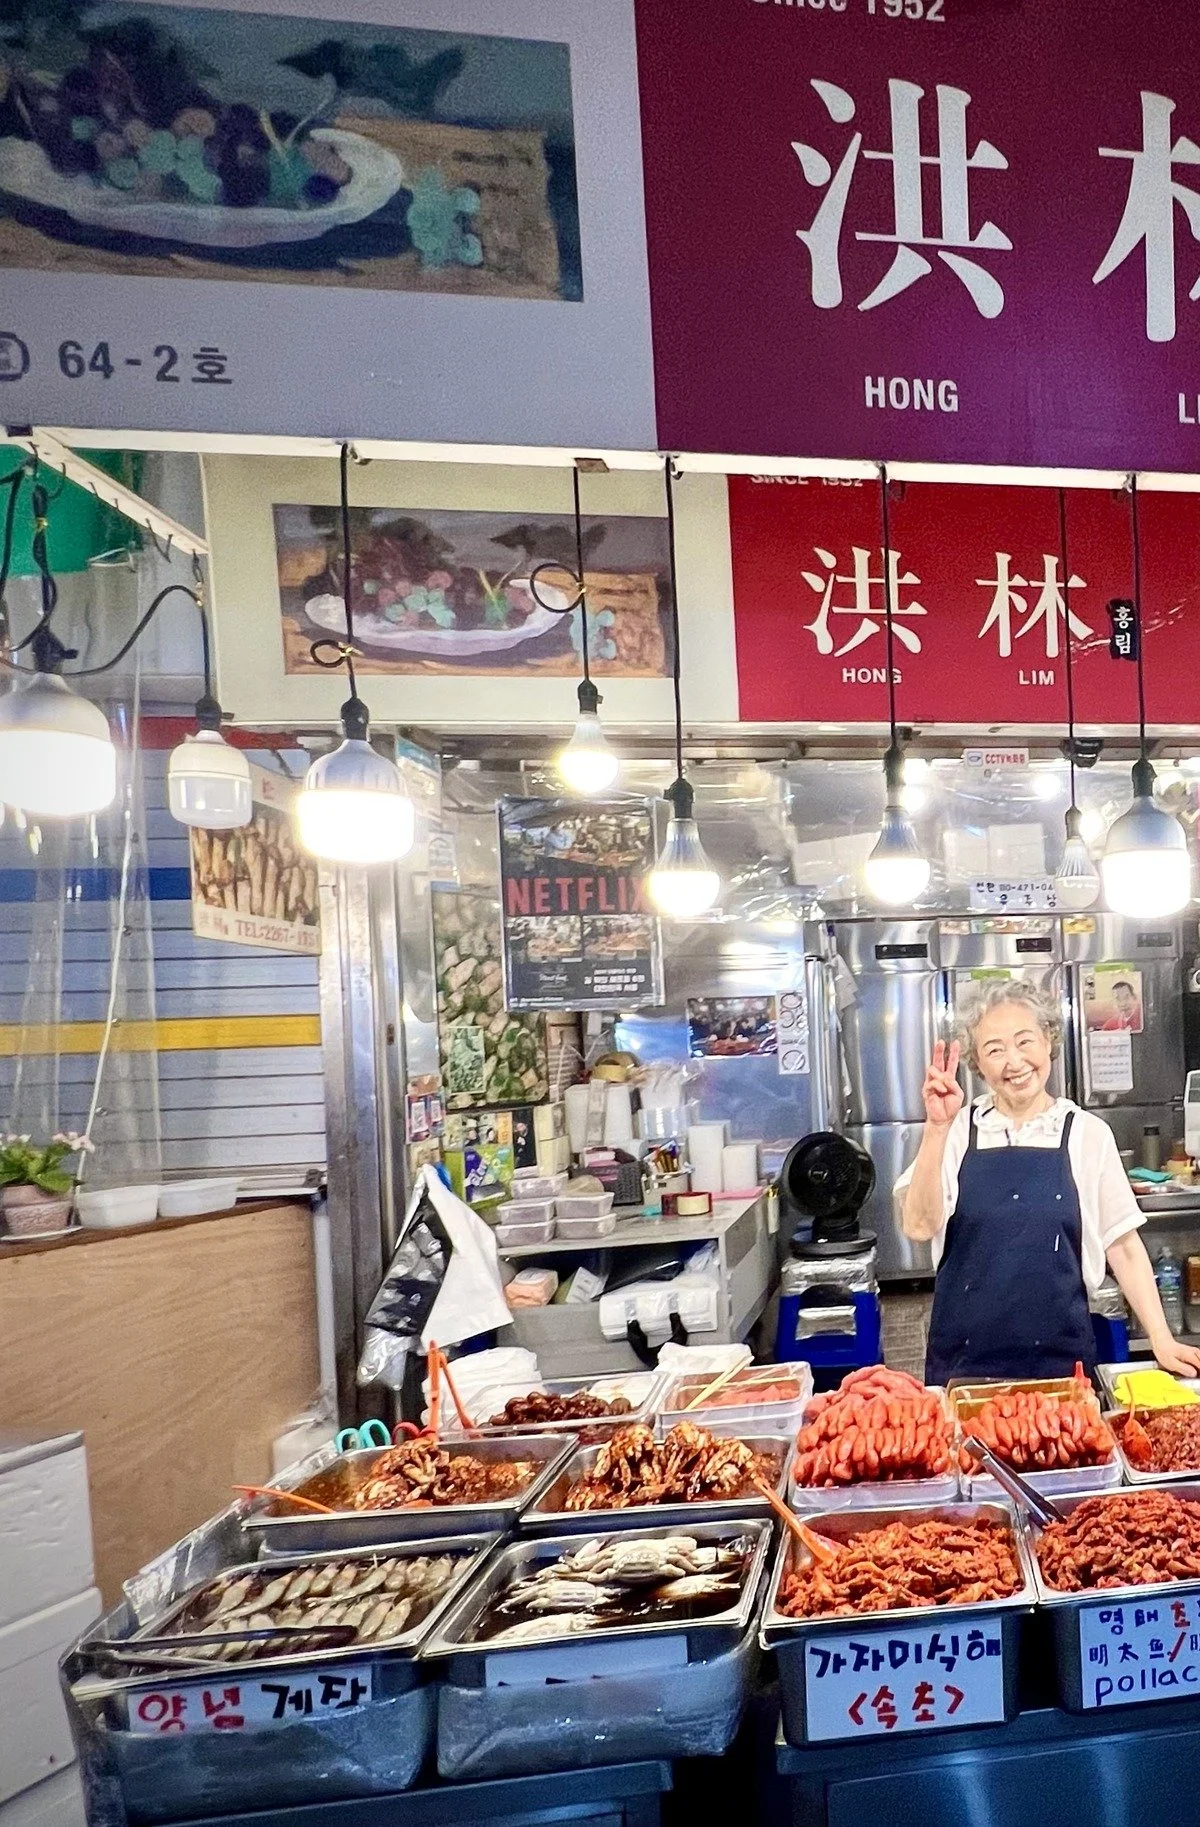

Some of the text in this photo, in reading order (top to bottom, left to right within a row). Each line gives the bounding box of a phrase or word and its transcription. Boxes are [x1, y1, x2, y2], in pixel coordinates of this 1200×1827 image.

[864, 375, 960, 414] HONG
[1114, 606, 1133, 656] 홍림
[842, 666, 1055, 686] HONG LIM
[507, 875, 650, 917] NETFLIX
[809, 1629, 1001, 1678] 가자미식해
